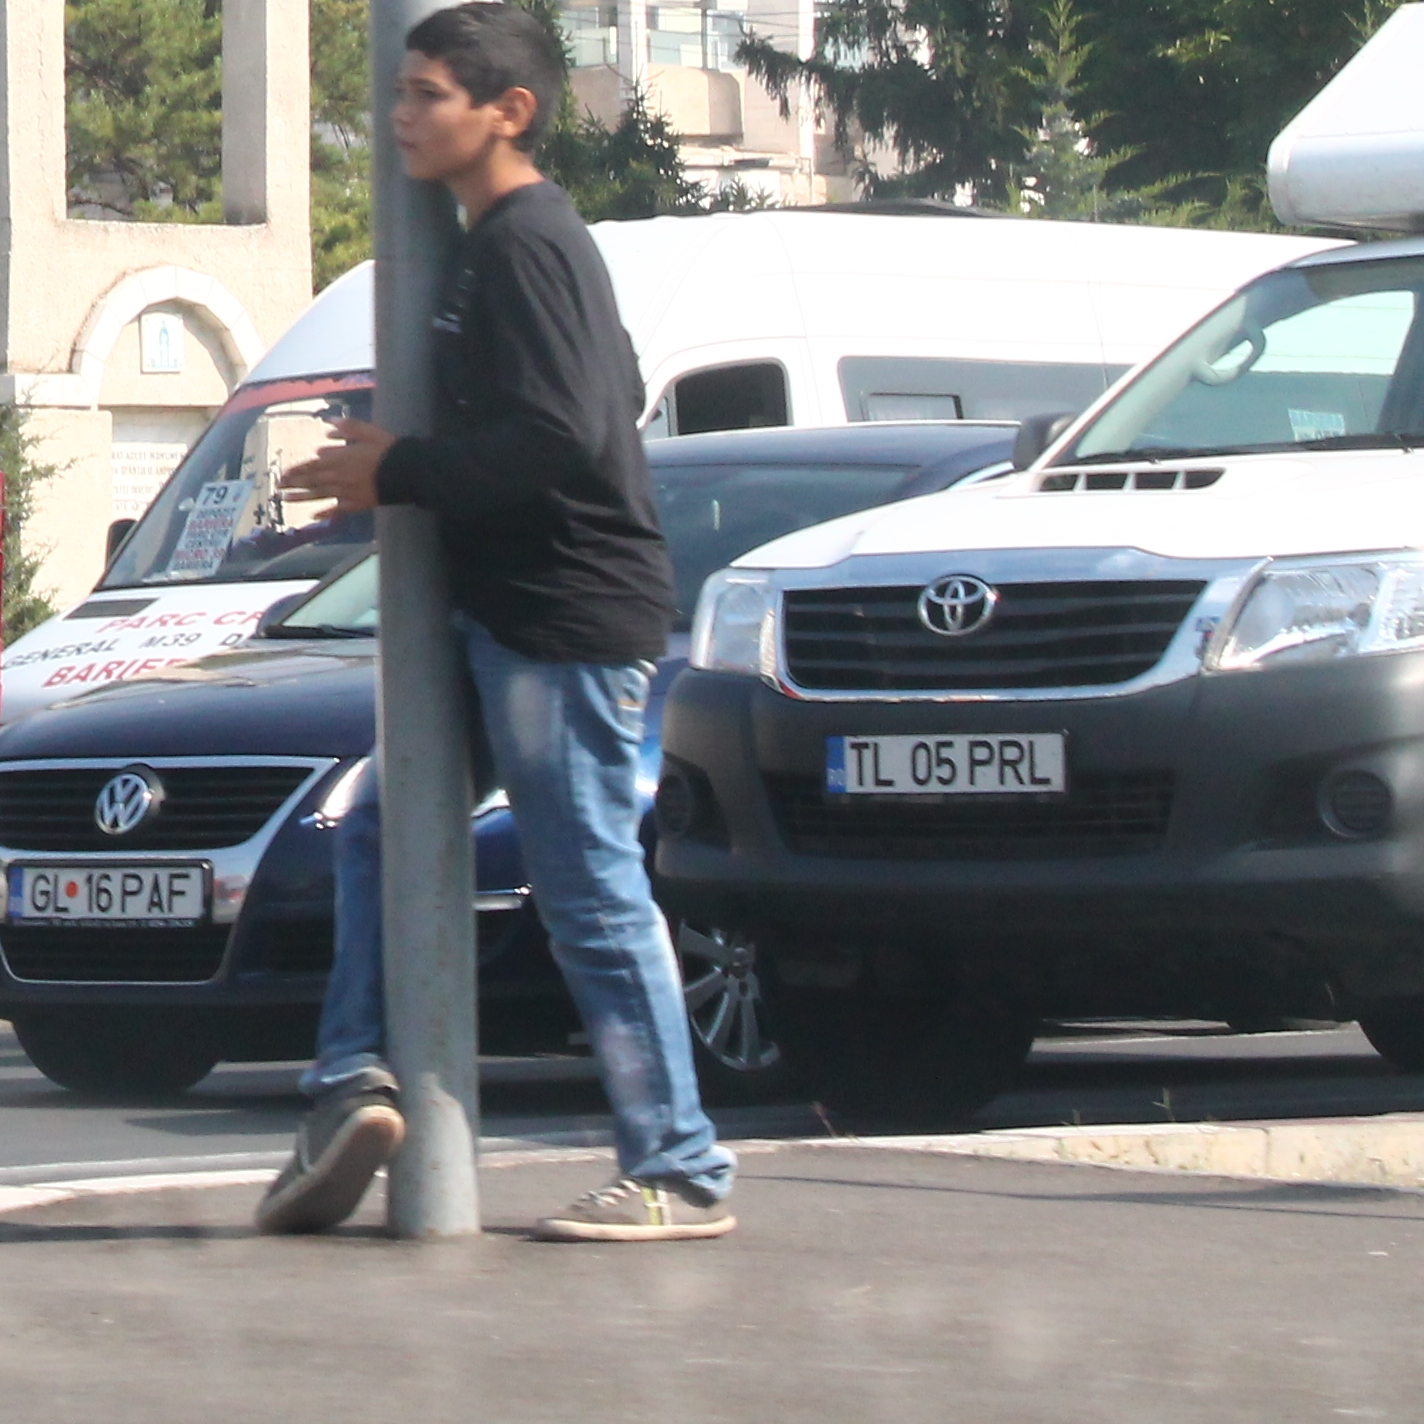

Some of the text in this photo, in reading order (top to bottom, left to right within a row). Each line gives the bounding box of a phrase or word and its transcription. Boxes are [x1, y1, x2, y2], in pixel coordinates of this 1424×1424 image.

[203, 486, 228, 505] 79
[95, 610, 263, 633] PARC CR
[0, 637, 120, 670] GENERAL
[849, 739, 1051, 787] TL 05 PRL
[31, 874, 70, 913] GL
[121, 873, 190, 913] PAF
